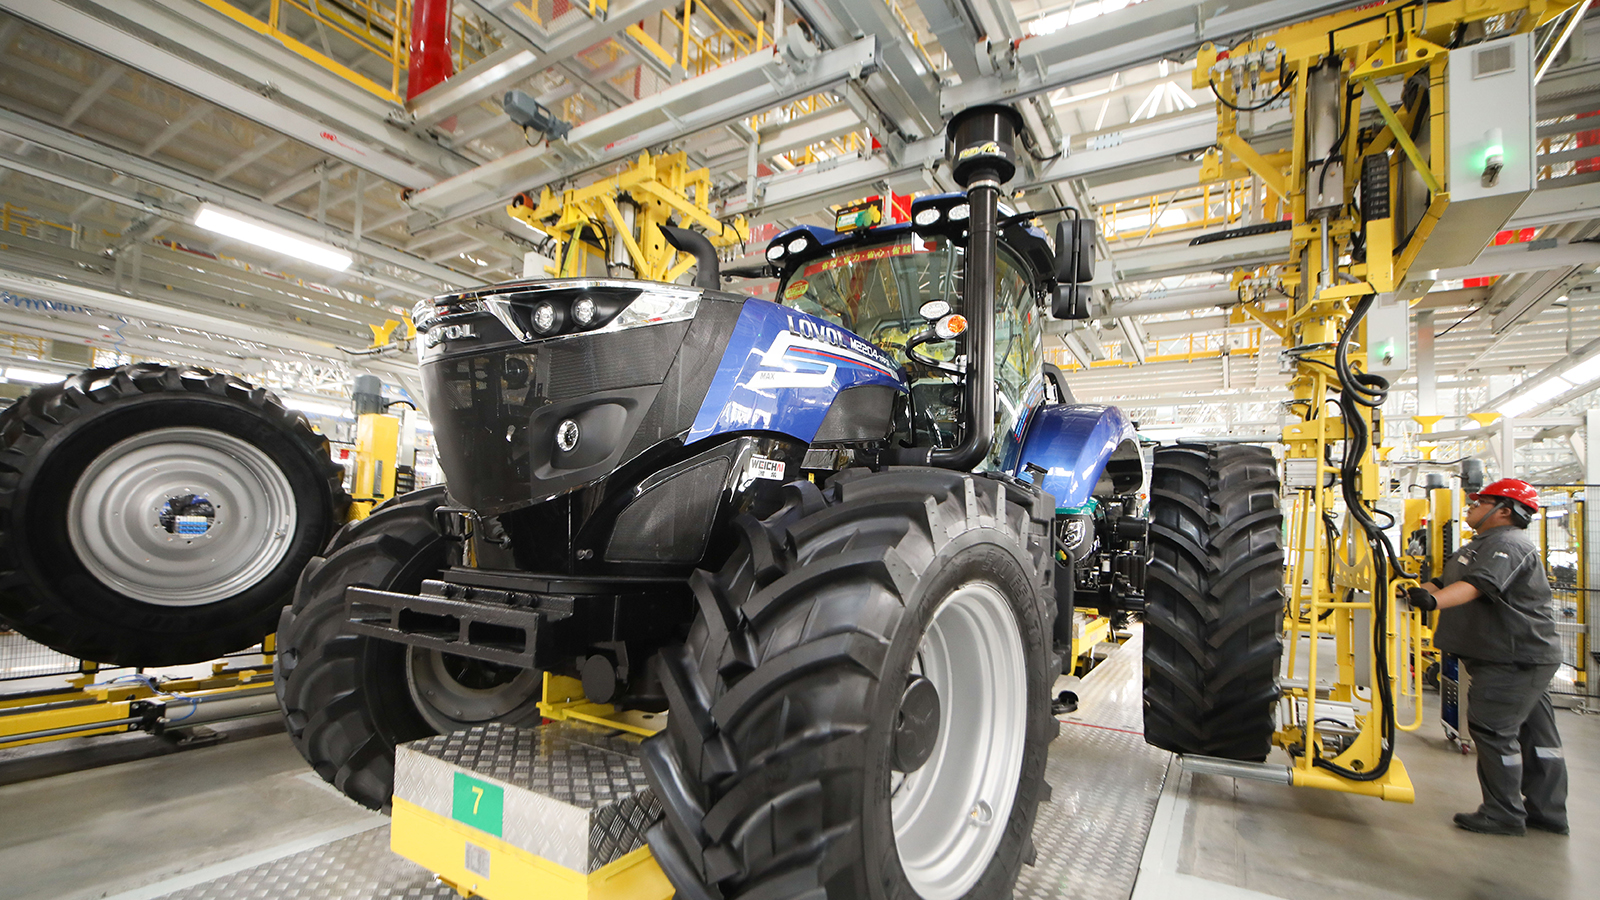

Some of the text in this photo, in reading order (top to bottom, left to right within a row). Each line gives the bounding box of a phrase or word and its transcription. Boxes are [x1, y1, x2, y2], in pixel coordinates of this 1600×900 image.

[787, 314, 848, 350] LOVOL
[760, 372, 775, 380] MAX
[471, 785, 484, 815] 7
